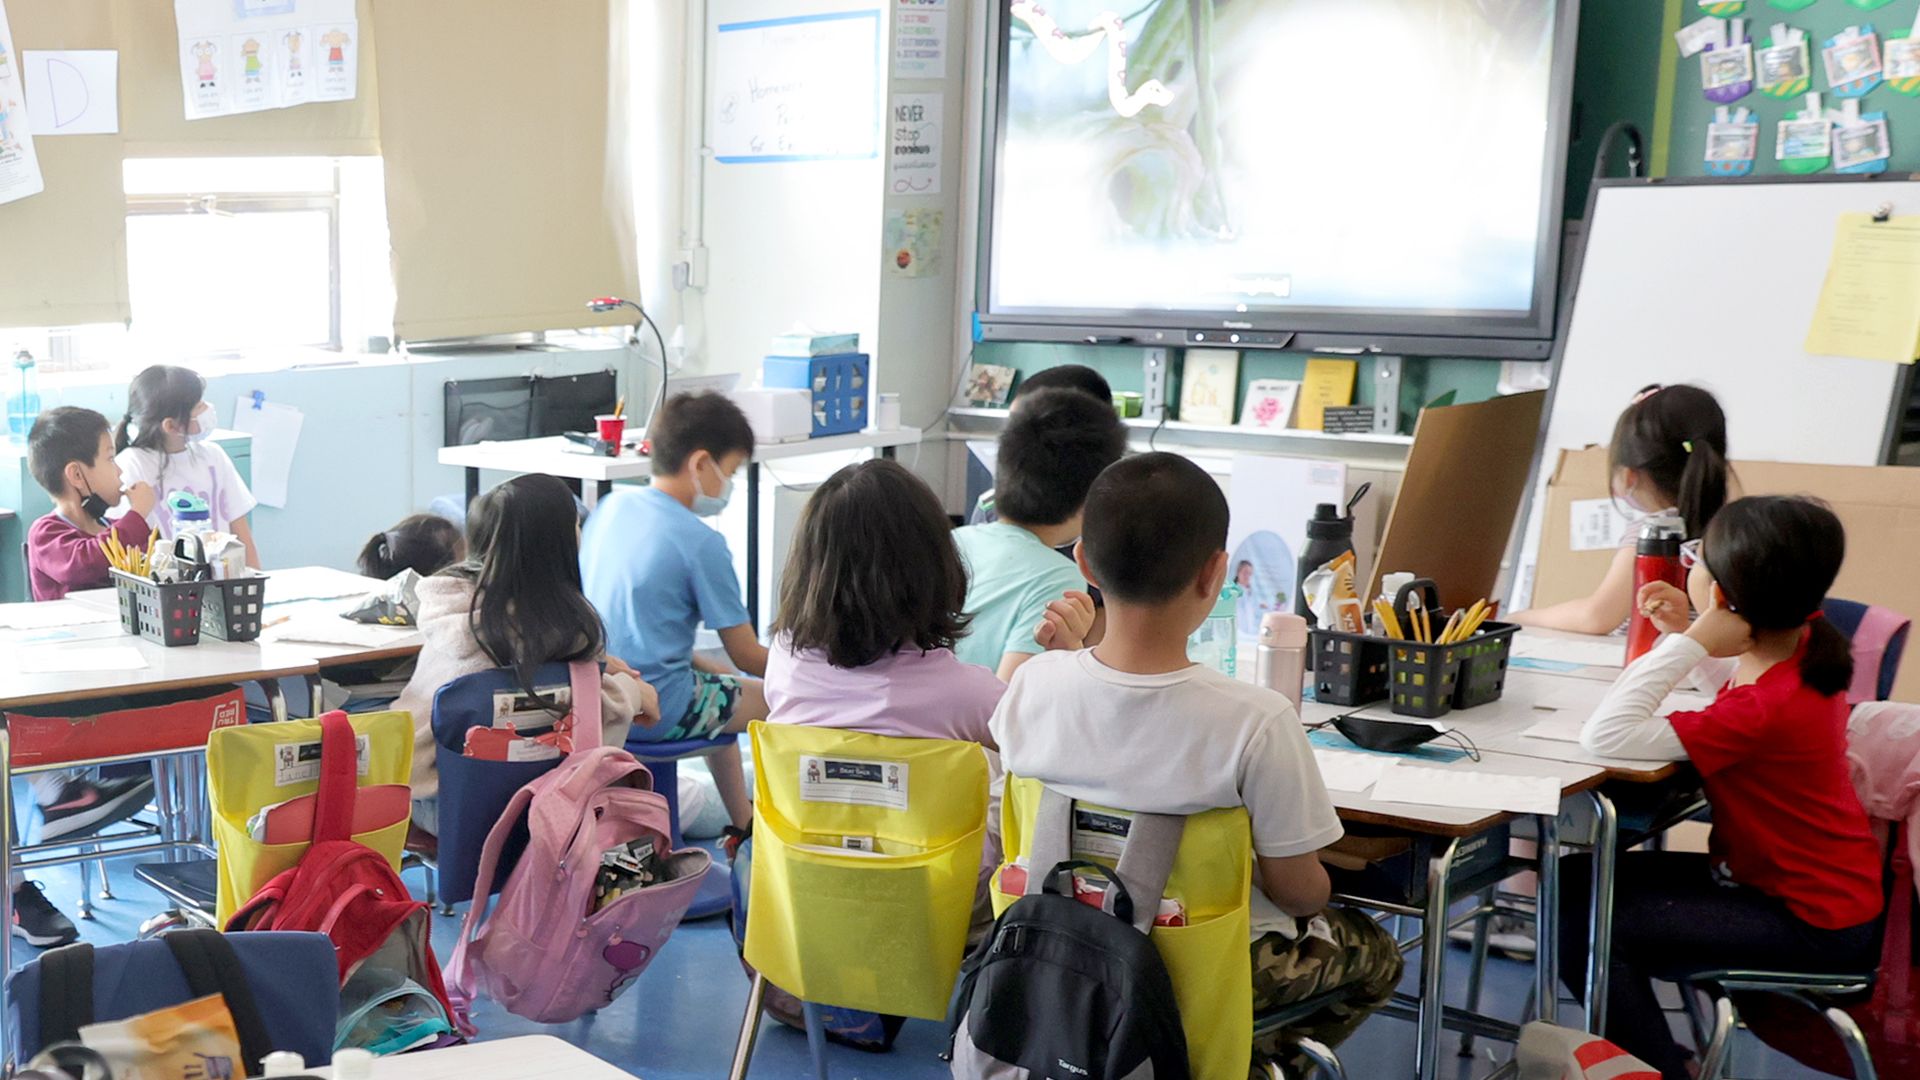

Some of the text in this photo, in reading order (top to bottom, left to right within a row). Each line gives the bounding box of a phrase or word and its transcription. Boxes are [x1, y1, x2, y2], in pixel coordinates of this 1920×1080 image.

[47, 58, 89, 128] D
[895, 105, 924, 122] NEVER
[1058, 1059, 1088, 1075] Targus
